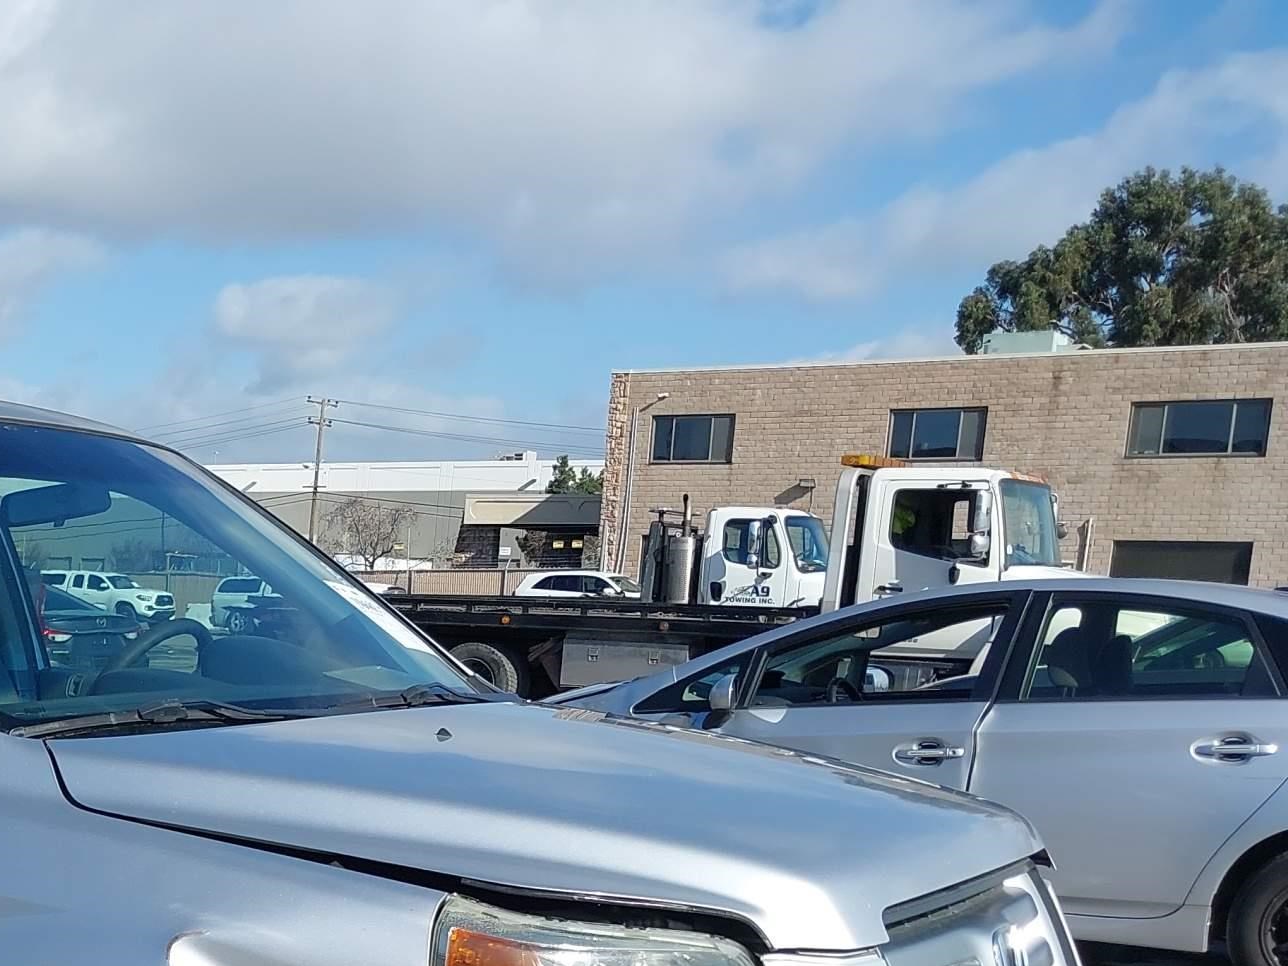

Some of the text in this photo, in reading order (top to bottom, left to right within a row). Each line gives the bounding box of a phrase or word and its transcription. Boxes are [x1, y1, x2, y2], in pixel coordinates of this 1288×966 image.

[750, 585, 771, 597] A9
[725, 596, 776, 606] TOWING INC.
